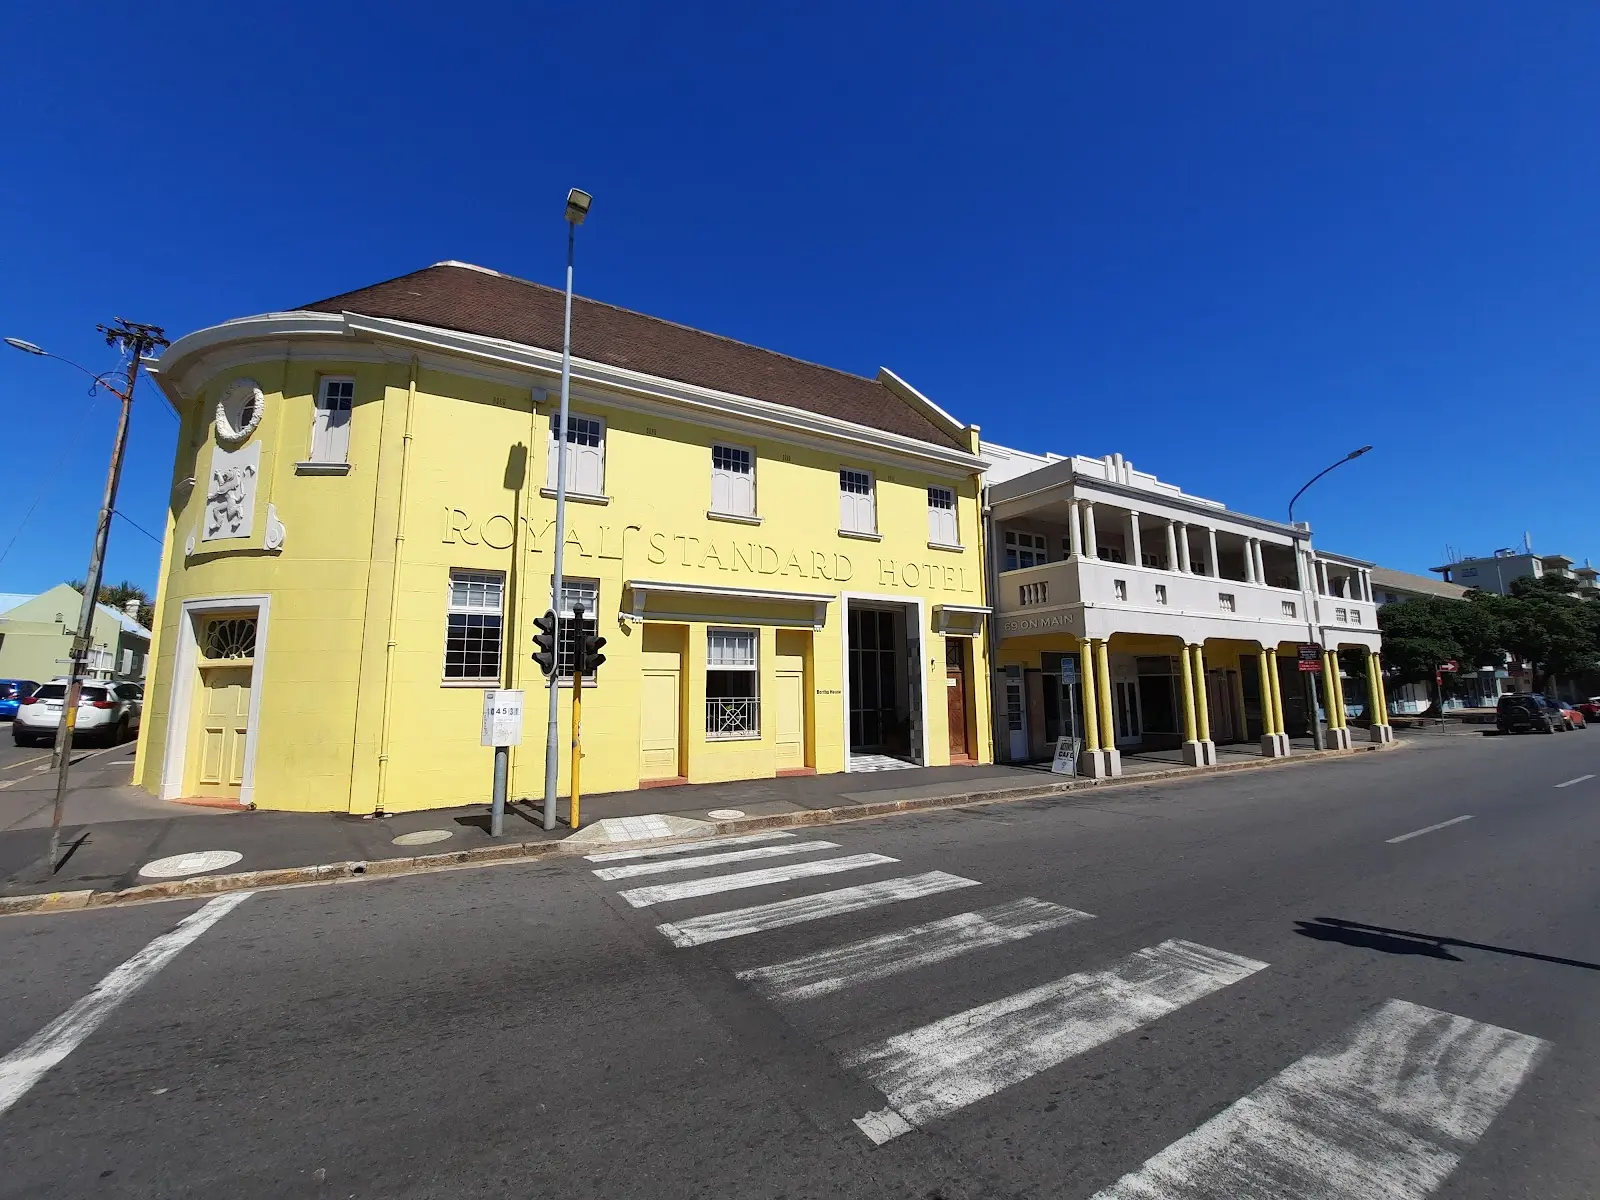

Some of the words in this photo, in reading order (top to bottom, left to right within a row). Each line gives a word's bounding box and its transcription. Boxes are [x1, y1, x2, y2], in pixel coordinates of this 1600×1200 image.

[442, 506, 622, 561] ROYAL
[647, 532, 854, 582] STANDARD
[877, 558, 974, 593] HOTEL
[1004, 621, 1018, 631] 69
[1020, 619, 1038, 629] ON
[1040, 614, 1074, 628] MAIN
